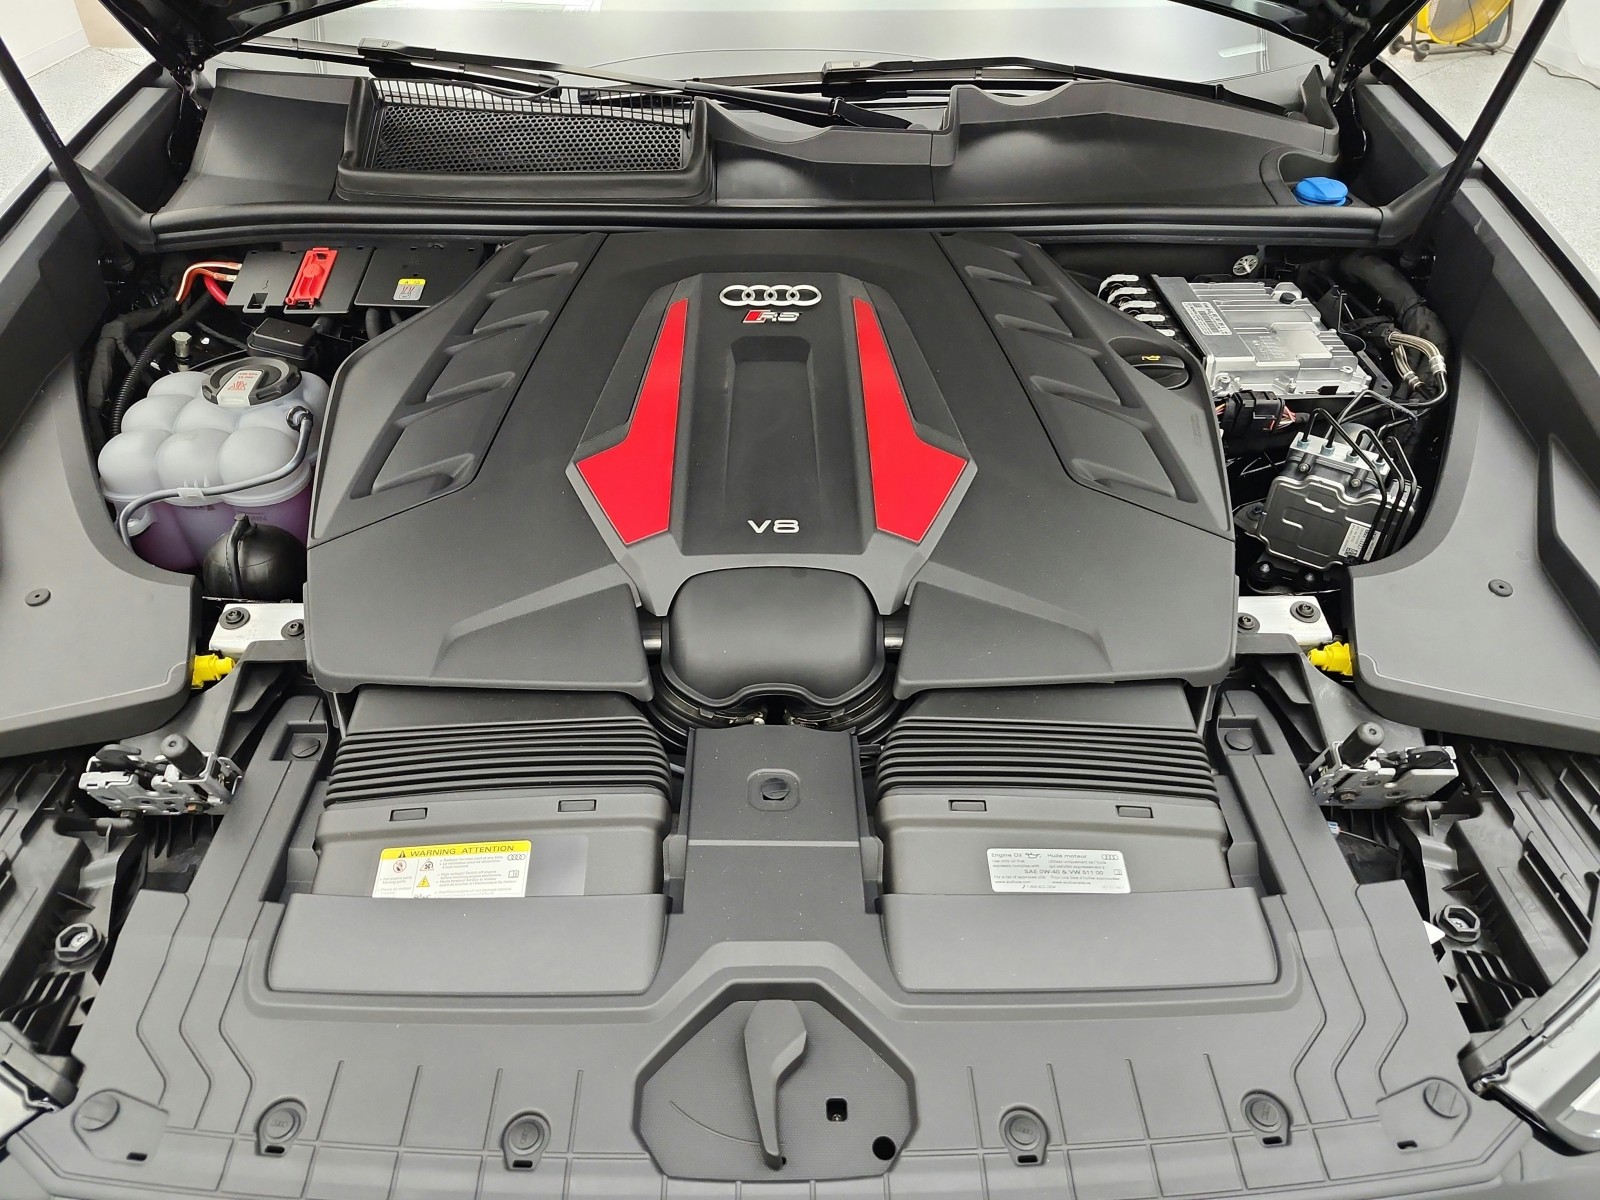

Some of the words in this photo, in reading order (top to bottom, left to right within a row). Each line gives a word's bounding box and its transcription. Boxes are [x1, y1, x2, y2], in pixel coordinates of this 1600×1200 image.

[743, 309, 800, 323] RS
[747, 519, 800, 533] V8
[410, 848, 456, 857] WARNING
[461, 845, 514, 854] ATTENTION
